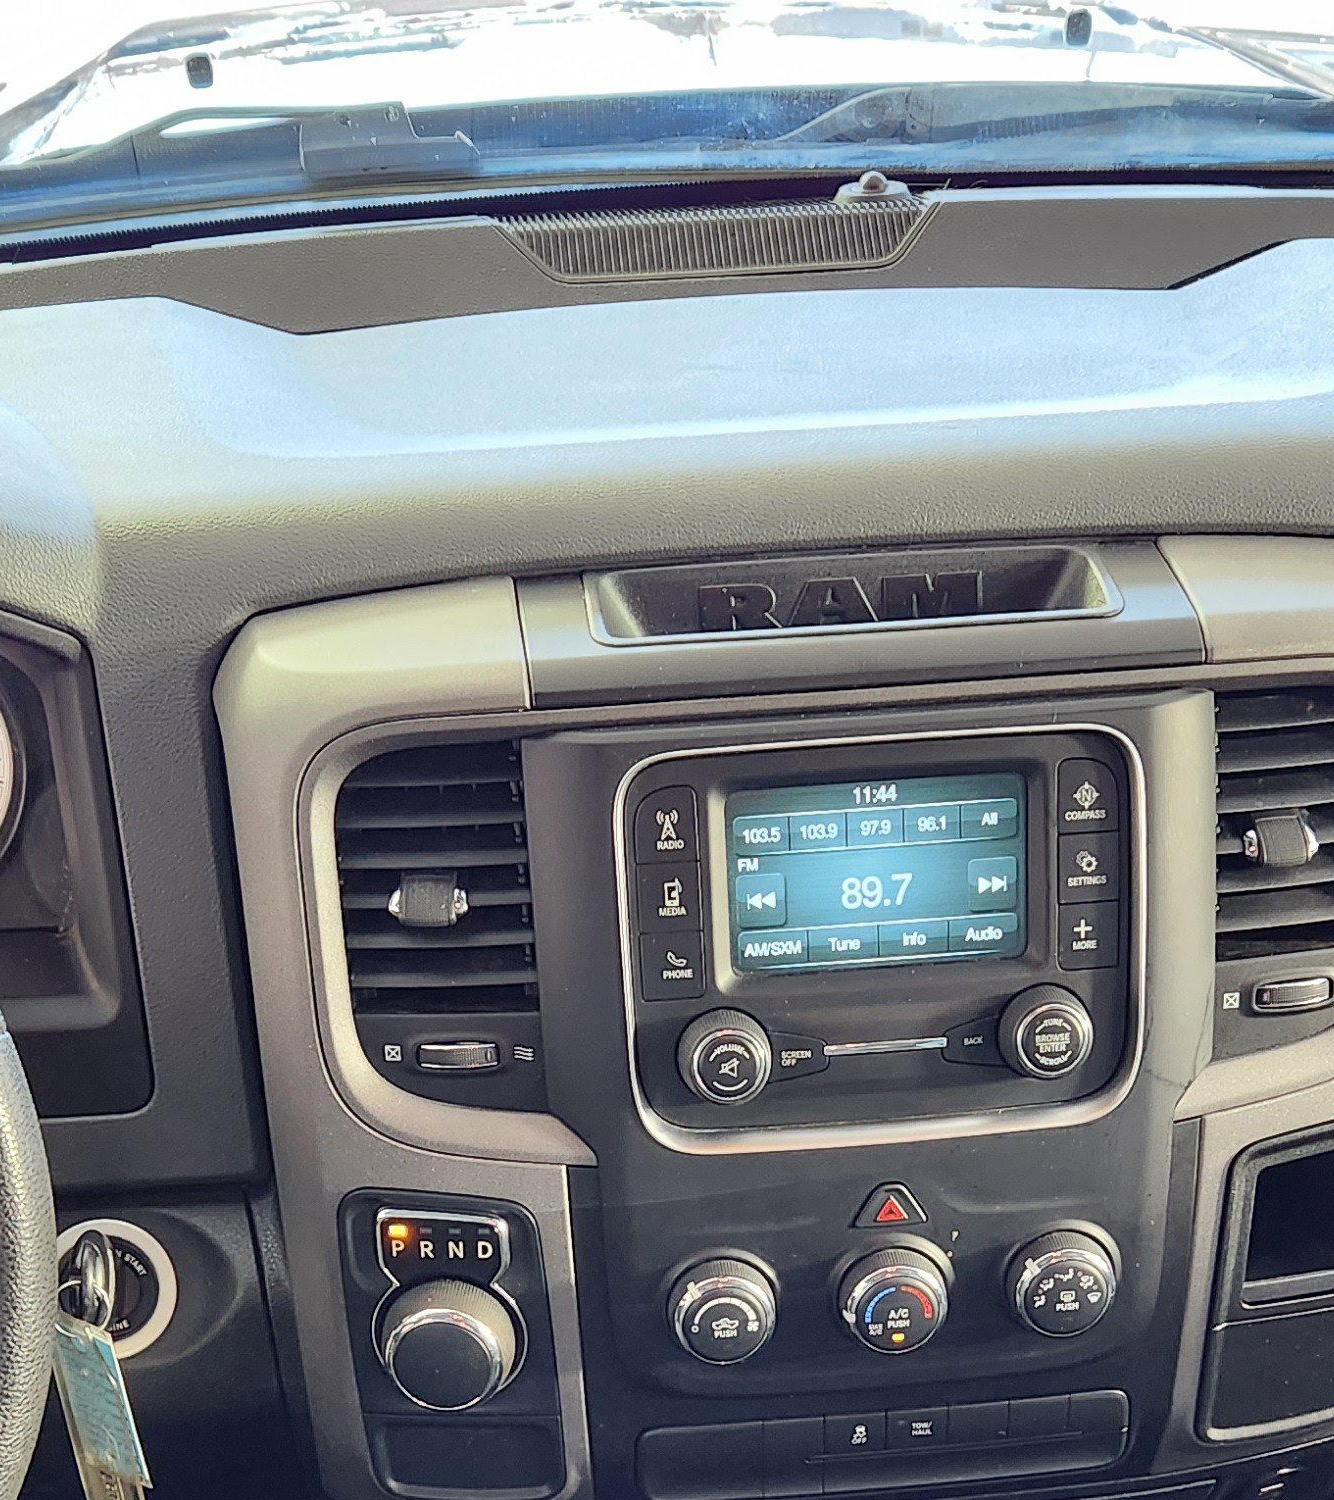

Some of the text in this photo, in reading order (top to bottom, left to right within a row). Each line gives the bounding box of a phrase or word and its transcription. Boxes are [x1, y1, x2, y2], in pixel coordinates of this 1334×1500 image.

[698, 570, 983, 631] RAM
[853, 783, 898, 804] 11:44
[1064, 809, 1106, 821] COMPASS
[742, 812, 999, 844] 103.5 103.9 97.9 96.1 All
[656, 839, 685, 850] RADIO
[737, 858, 759, 872] FM
[1067, 875, 1107, 887] SETTINGS
[841, 873, 914, 910] 89.7
[658, 906, 687, 917] MEDIA
[744, 926, 1002, 957] AM/SXM Tune Info Audio
[1072, 939, 1098, 951] MORE
[662, 968, 694, 980] PHONE
[963, 1035, 983, 1046] BACK
[1035, 1032, 1071, 1043] BROWSE
[1039, 1043, 1067, 1053] ENTER
[781, 1050, 812, 1059] SCREEN
[781, 1058, 797, 1067] OFF
[391, 1239, 493, 1259] P R N D
[124, 1252, 148, 1276] START
[1055, 1302, 1079, 1312] PUSH
[888, 1308, 909, 1319] A/C
[887, 1319, 910, 1329] PUSH
[714, 1329, 737, 1339] PUSH
